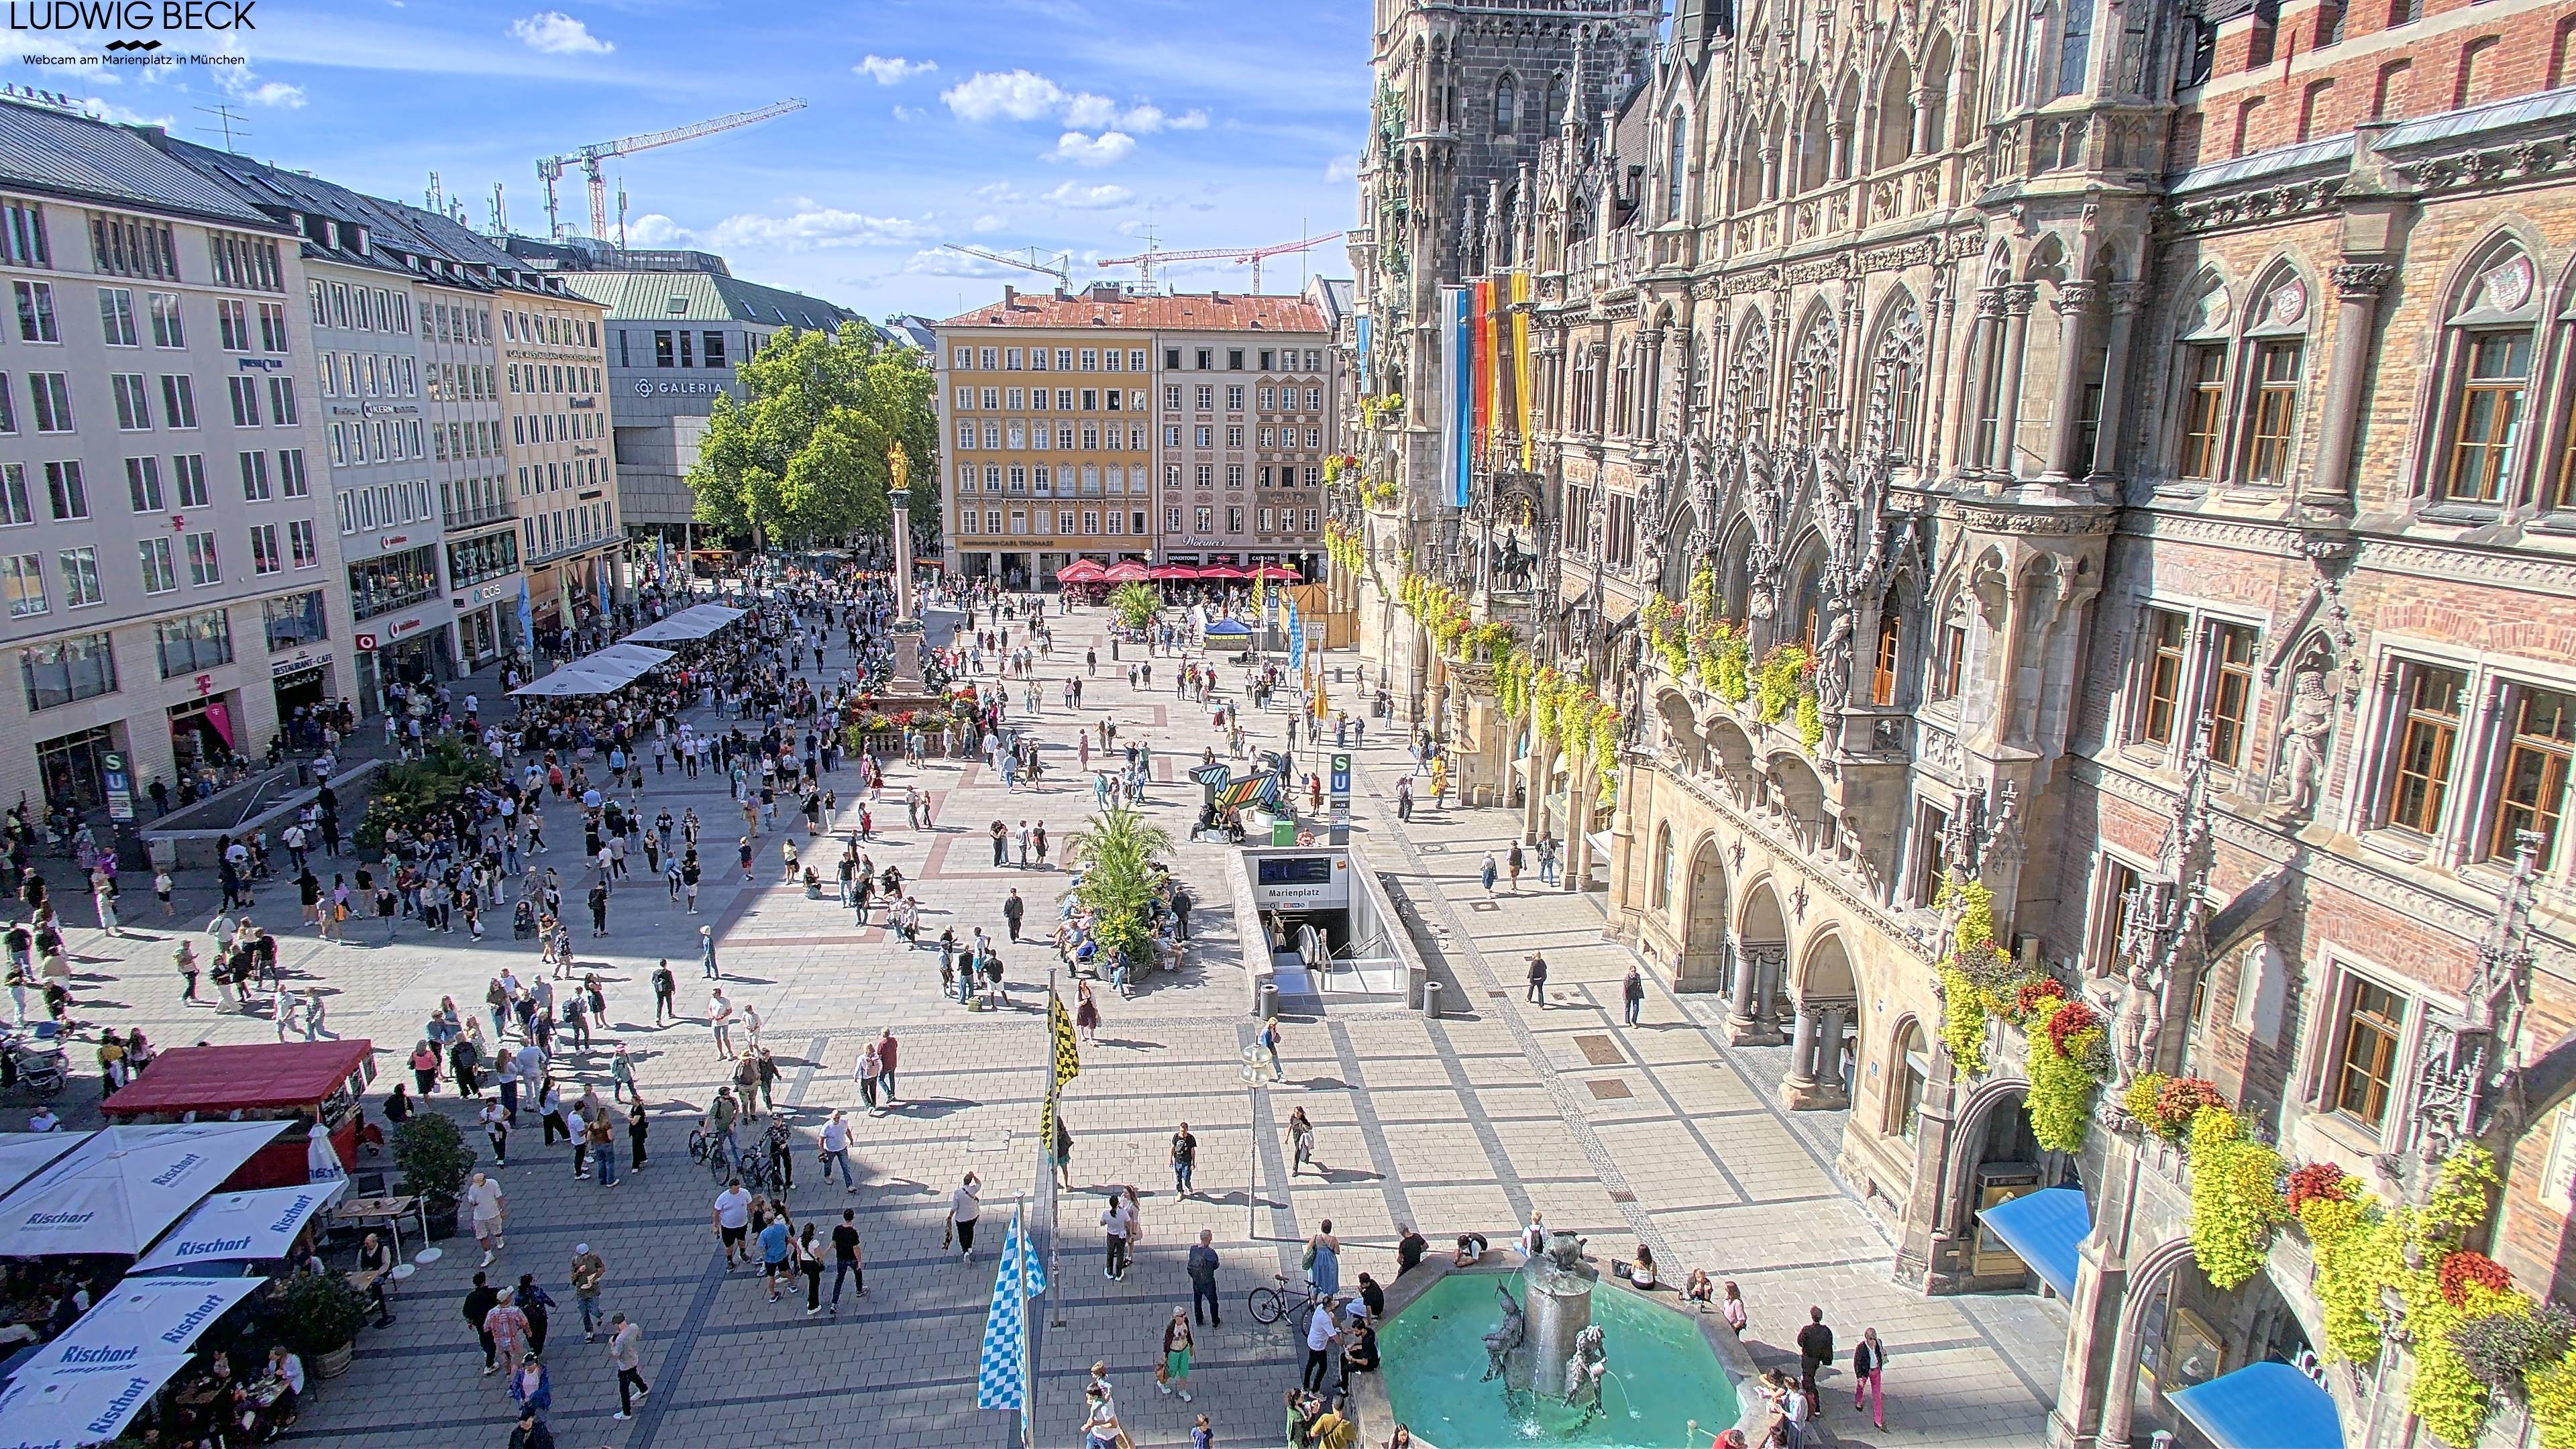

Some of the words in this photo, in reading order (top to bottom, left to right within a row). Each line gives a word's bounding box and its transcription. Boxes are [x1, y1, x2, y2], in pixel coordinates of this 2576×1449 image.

[659, 382, 722, 393] GALERIA
[1183, 535, 1225, 547] Woerner's
[480, 584, 501, 599] IQOS
[1270, 588, 1277, 597] S
[1270, 598, 1277, 607] U
[105, 754, 121, 771] S
[1334, 756, 1348, 771] S
[109, 774, 123, 789] U
[1334, 775, 1346, 790] U
[1269, 889, 1320, 898] Marienplatz
[150, 1152, 201, 1186] Rischart
[25, 1212, 95, 1224] Rischart
[270, 1194, 314, 1233] Rischart
[175, 1236, 252, 1256] Rischart
[161, 1293, 225, 1344] Rischart
[60, 1345, 139, 1363] Rischart
[86, 1377, 150, 1434] Rischart
